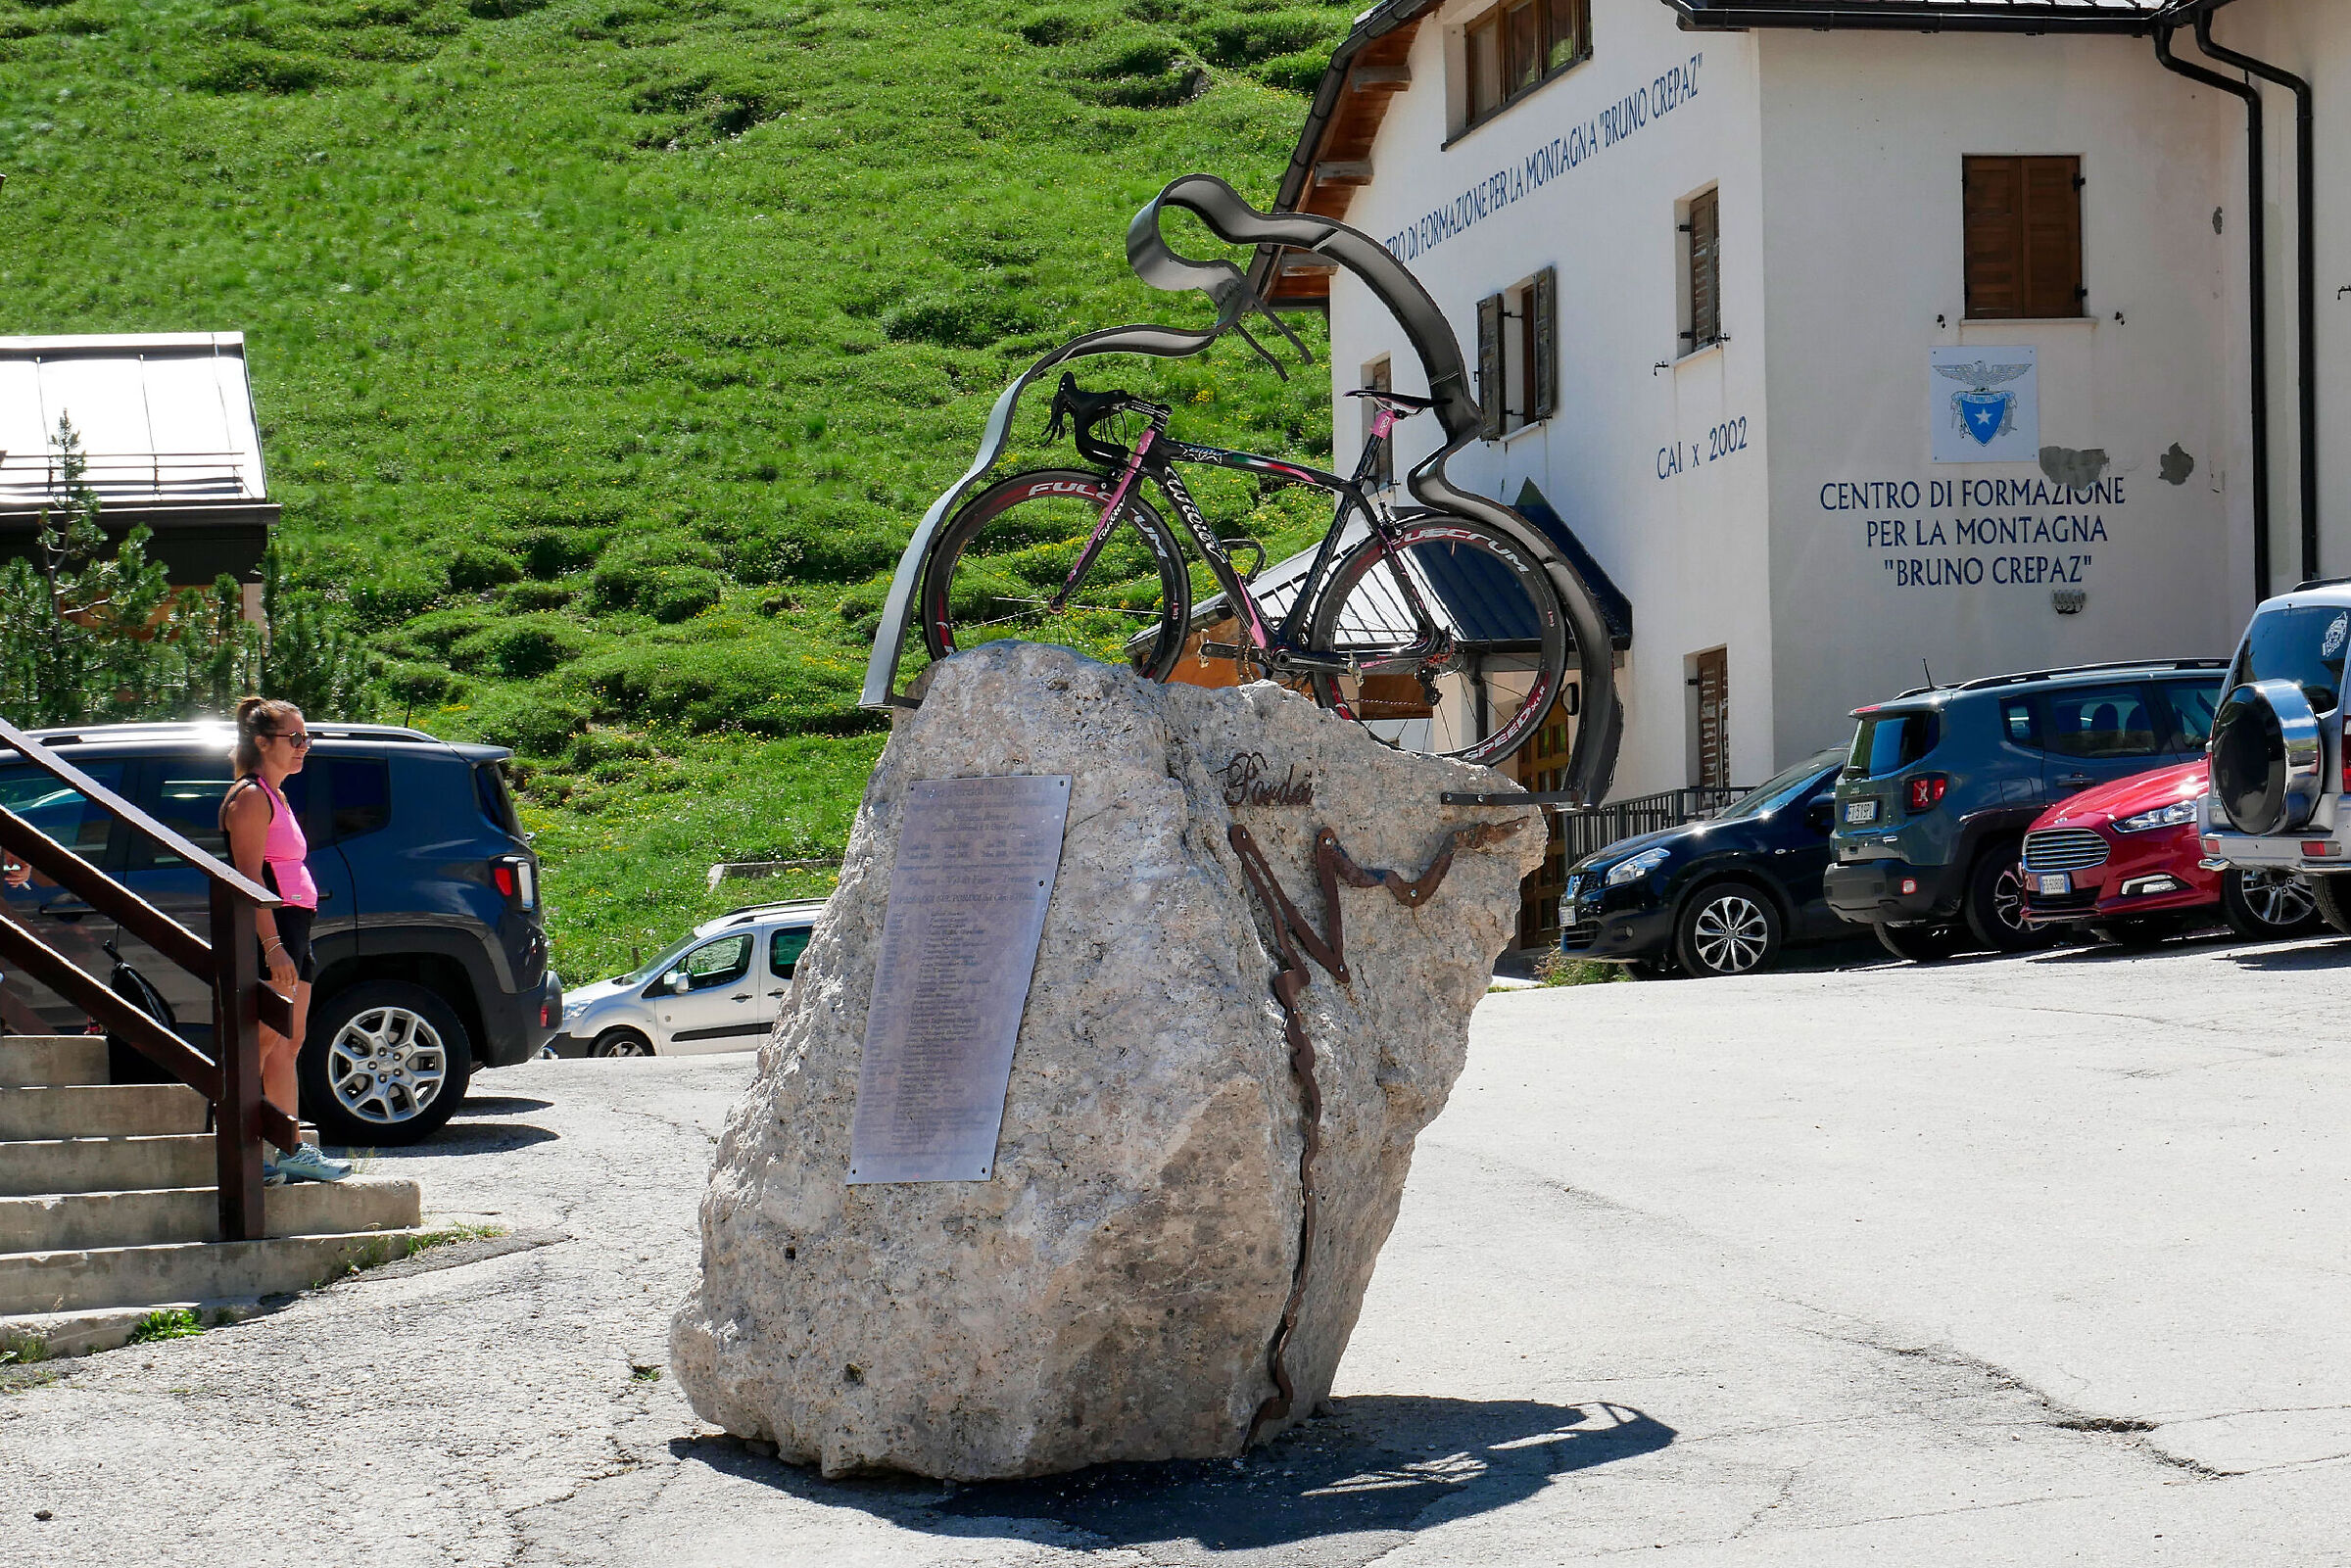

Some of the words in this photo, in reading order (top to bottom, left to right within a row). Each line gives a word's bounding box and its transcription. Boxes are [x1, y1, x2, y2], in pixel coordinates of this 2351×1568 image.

[1409, 223, 1419, 261] DI
[1420, 182, 1488, 254] FORMAZIONE
[1489, 171, 1509, 214] PER
[1510, 165, 1524, 204] LA
[1526, 119, 1599, 194] MONTAGNA
[1600, 87, 1648, 148] "BRUNO
[1652, 52, 1703, 119] CREPAZ"
[1656, 441, 1683, 479] CAI
[1709, 415, 1748, 461] 2002
[1820, 480, 1921, 510] CENTRO
[1930, 480, 1952, 508] DI
[1962, 476, 2126, 507] FORMAZIONE
[1867, 520, 1908, 546] PER
[1916, 519, 1946, 546] LA
[1955, 515, 2108, 545] MONTAGNA
[1885, 557, 1984, 587] "BRUNO
[1992, 555, 2092, 584] CREPAZ"
[1463, 707, 1532, 760] SPEED
